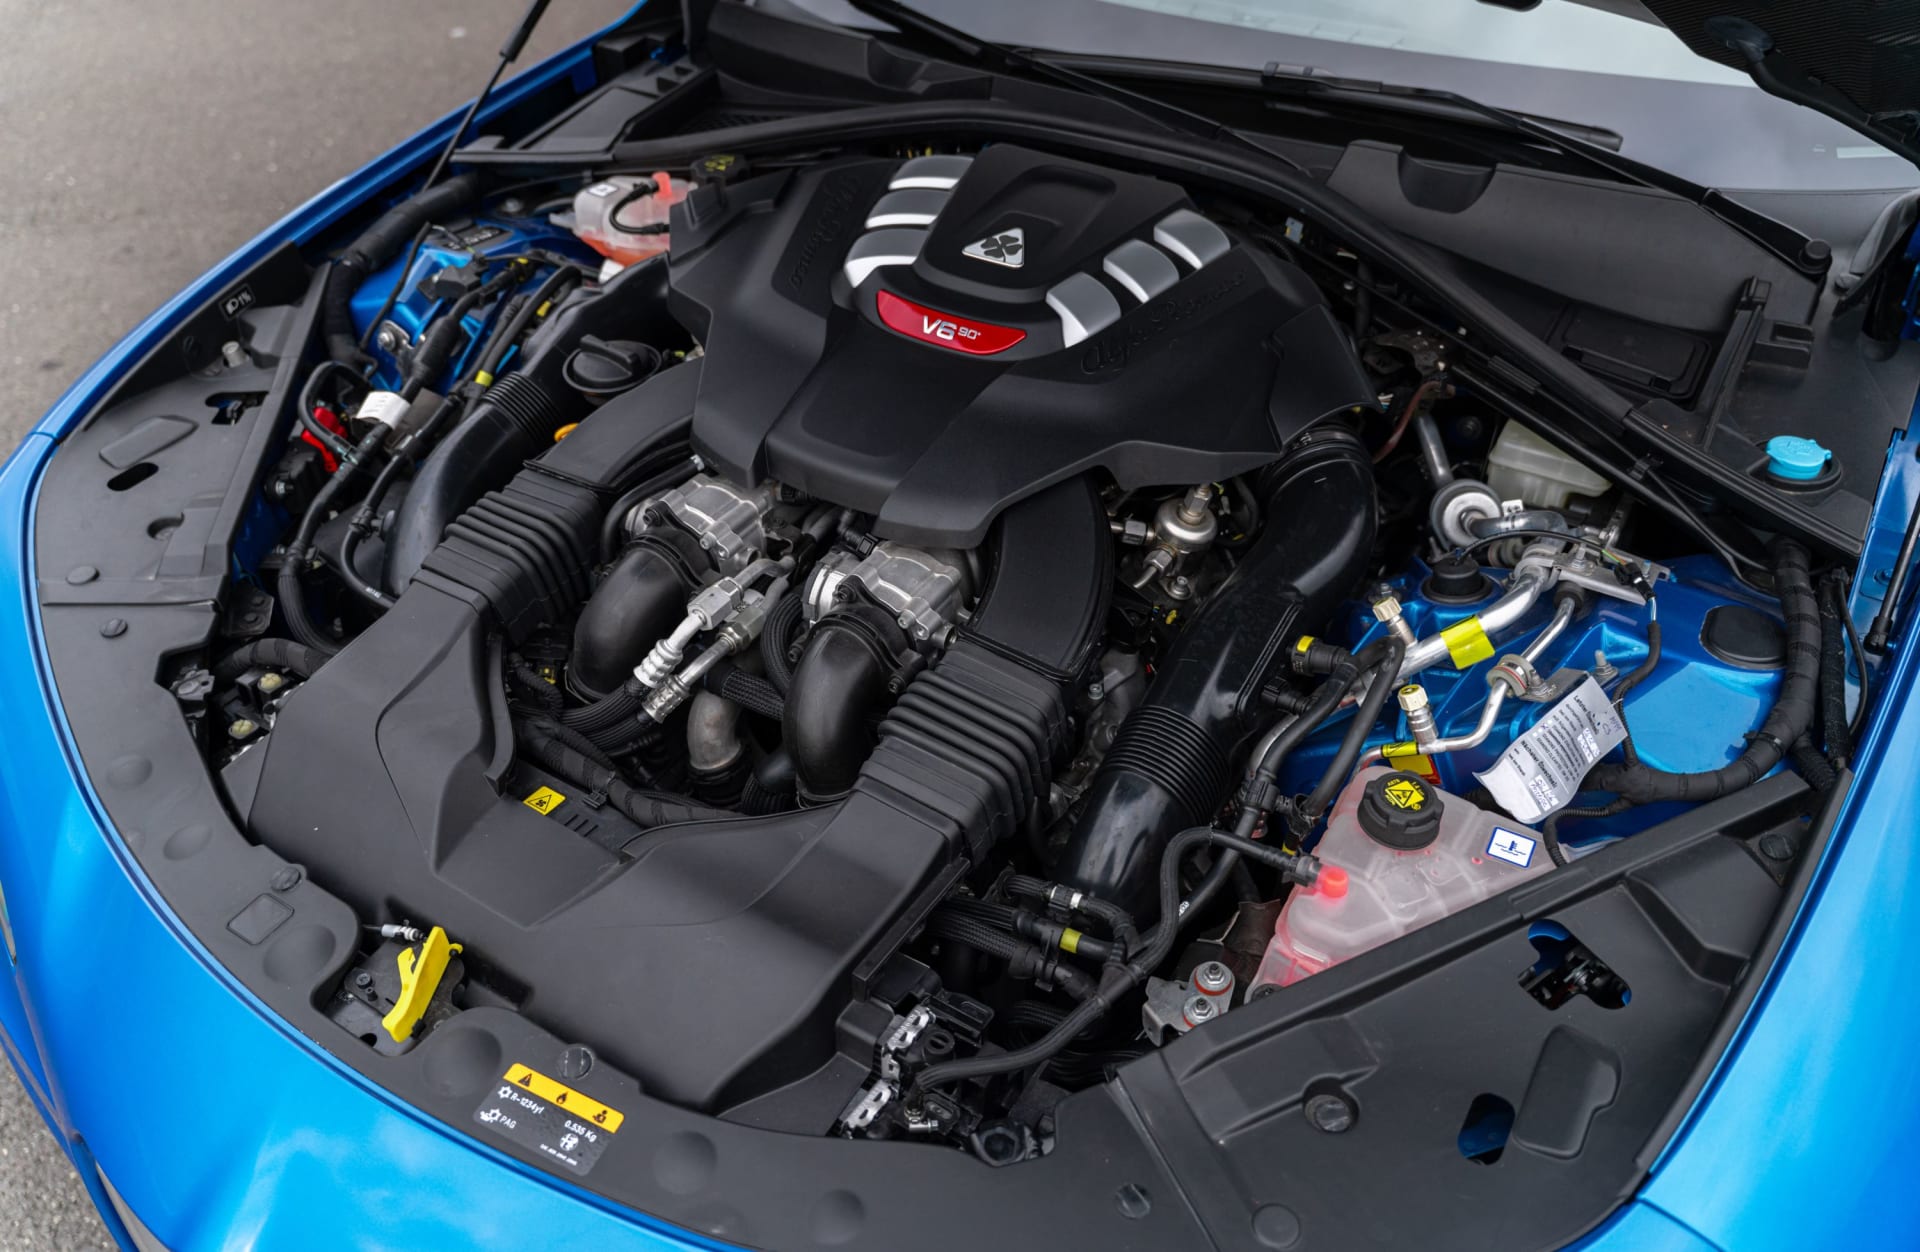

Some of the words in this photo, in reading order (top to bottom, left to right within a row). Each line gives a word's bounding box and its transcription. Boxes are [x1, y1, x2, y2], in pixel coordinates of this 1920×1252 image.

[922, 315, 957, 340] V6
[510, 1093, 545, 1115] R-1234yf
[499, 1116, 517, 1129] PAG
[584, 1130, 597, 1142] Kg
